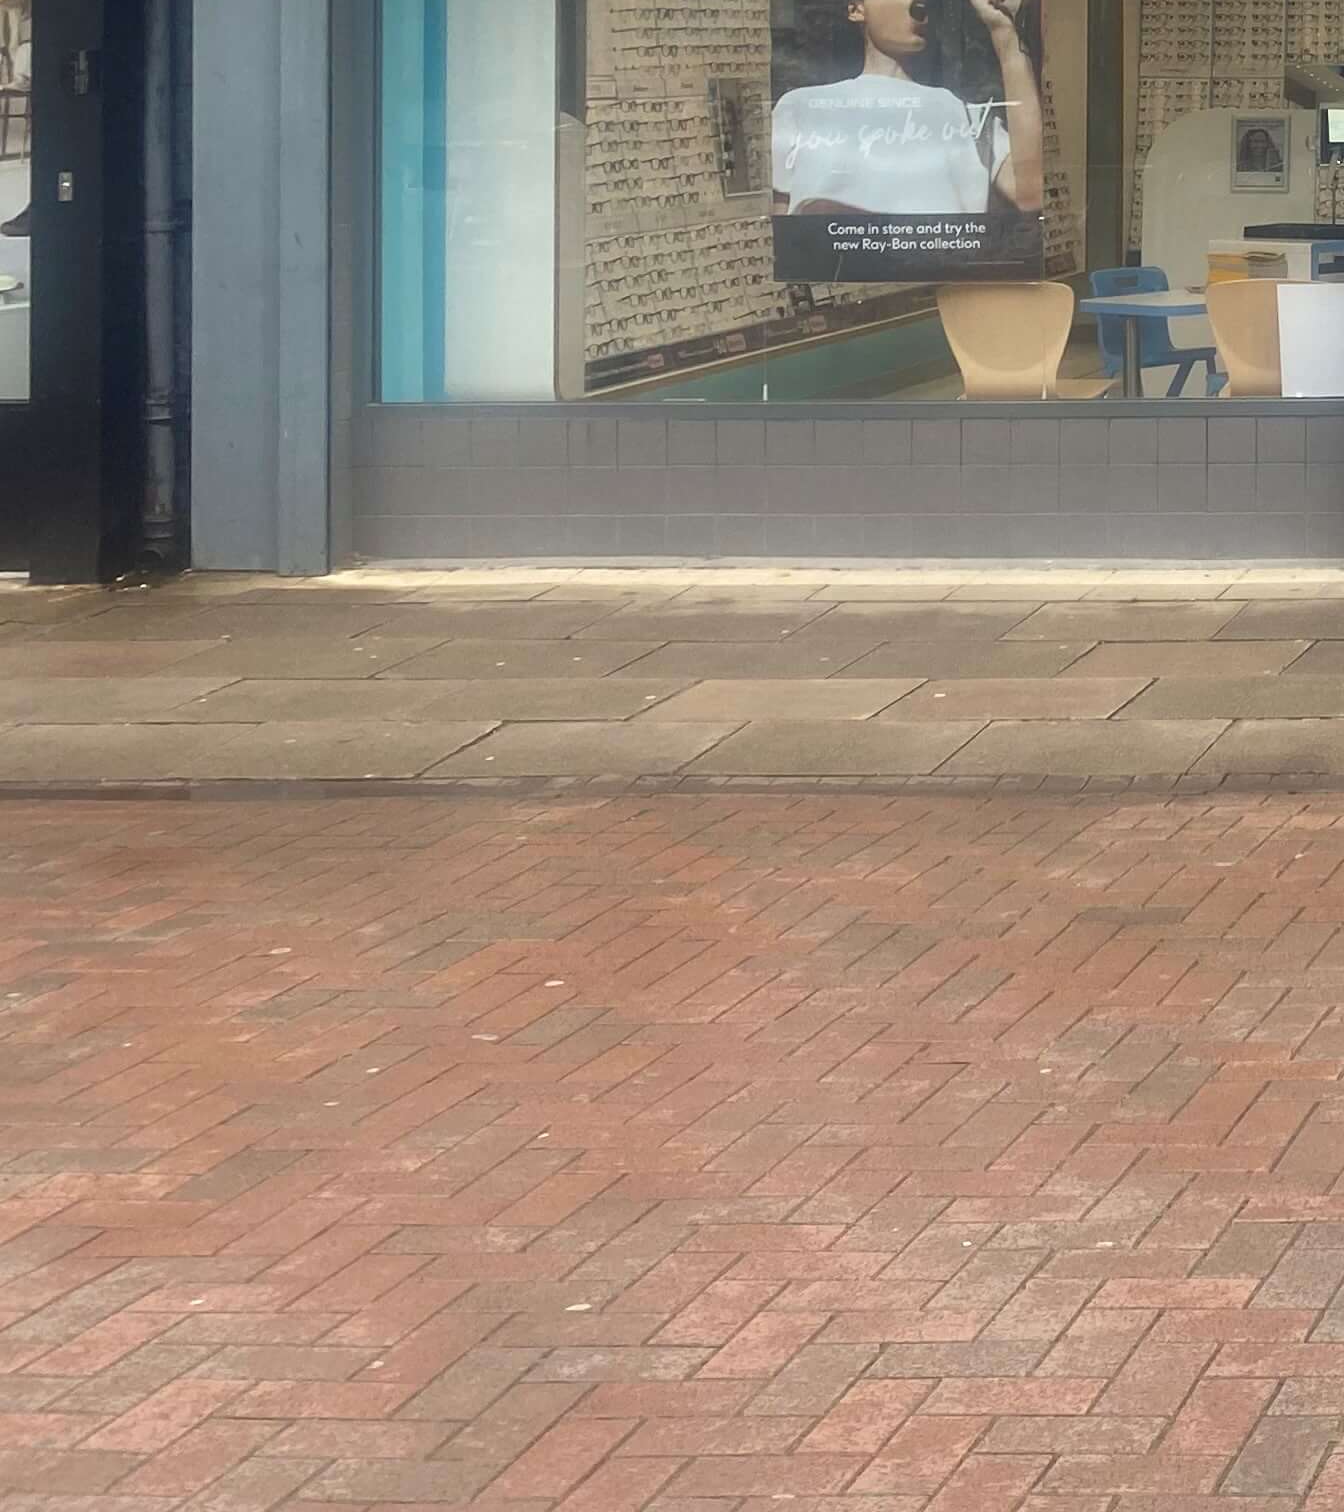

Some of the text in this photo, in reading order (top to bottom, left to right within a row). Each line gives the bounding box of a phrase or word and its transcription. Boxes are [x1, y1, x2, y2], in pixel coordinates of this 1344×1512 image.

[877, 96, 923, 108] SINCE
[827, 222, 986, 237] Come in store and try the
[833, 238, 981, 253] new Ray-Ban collection
